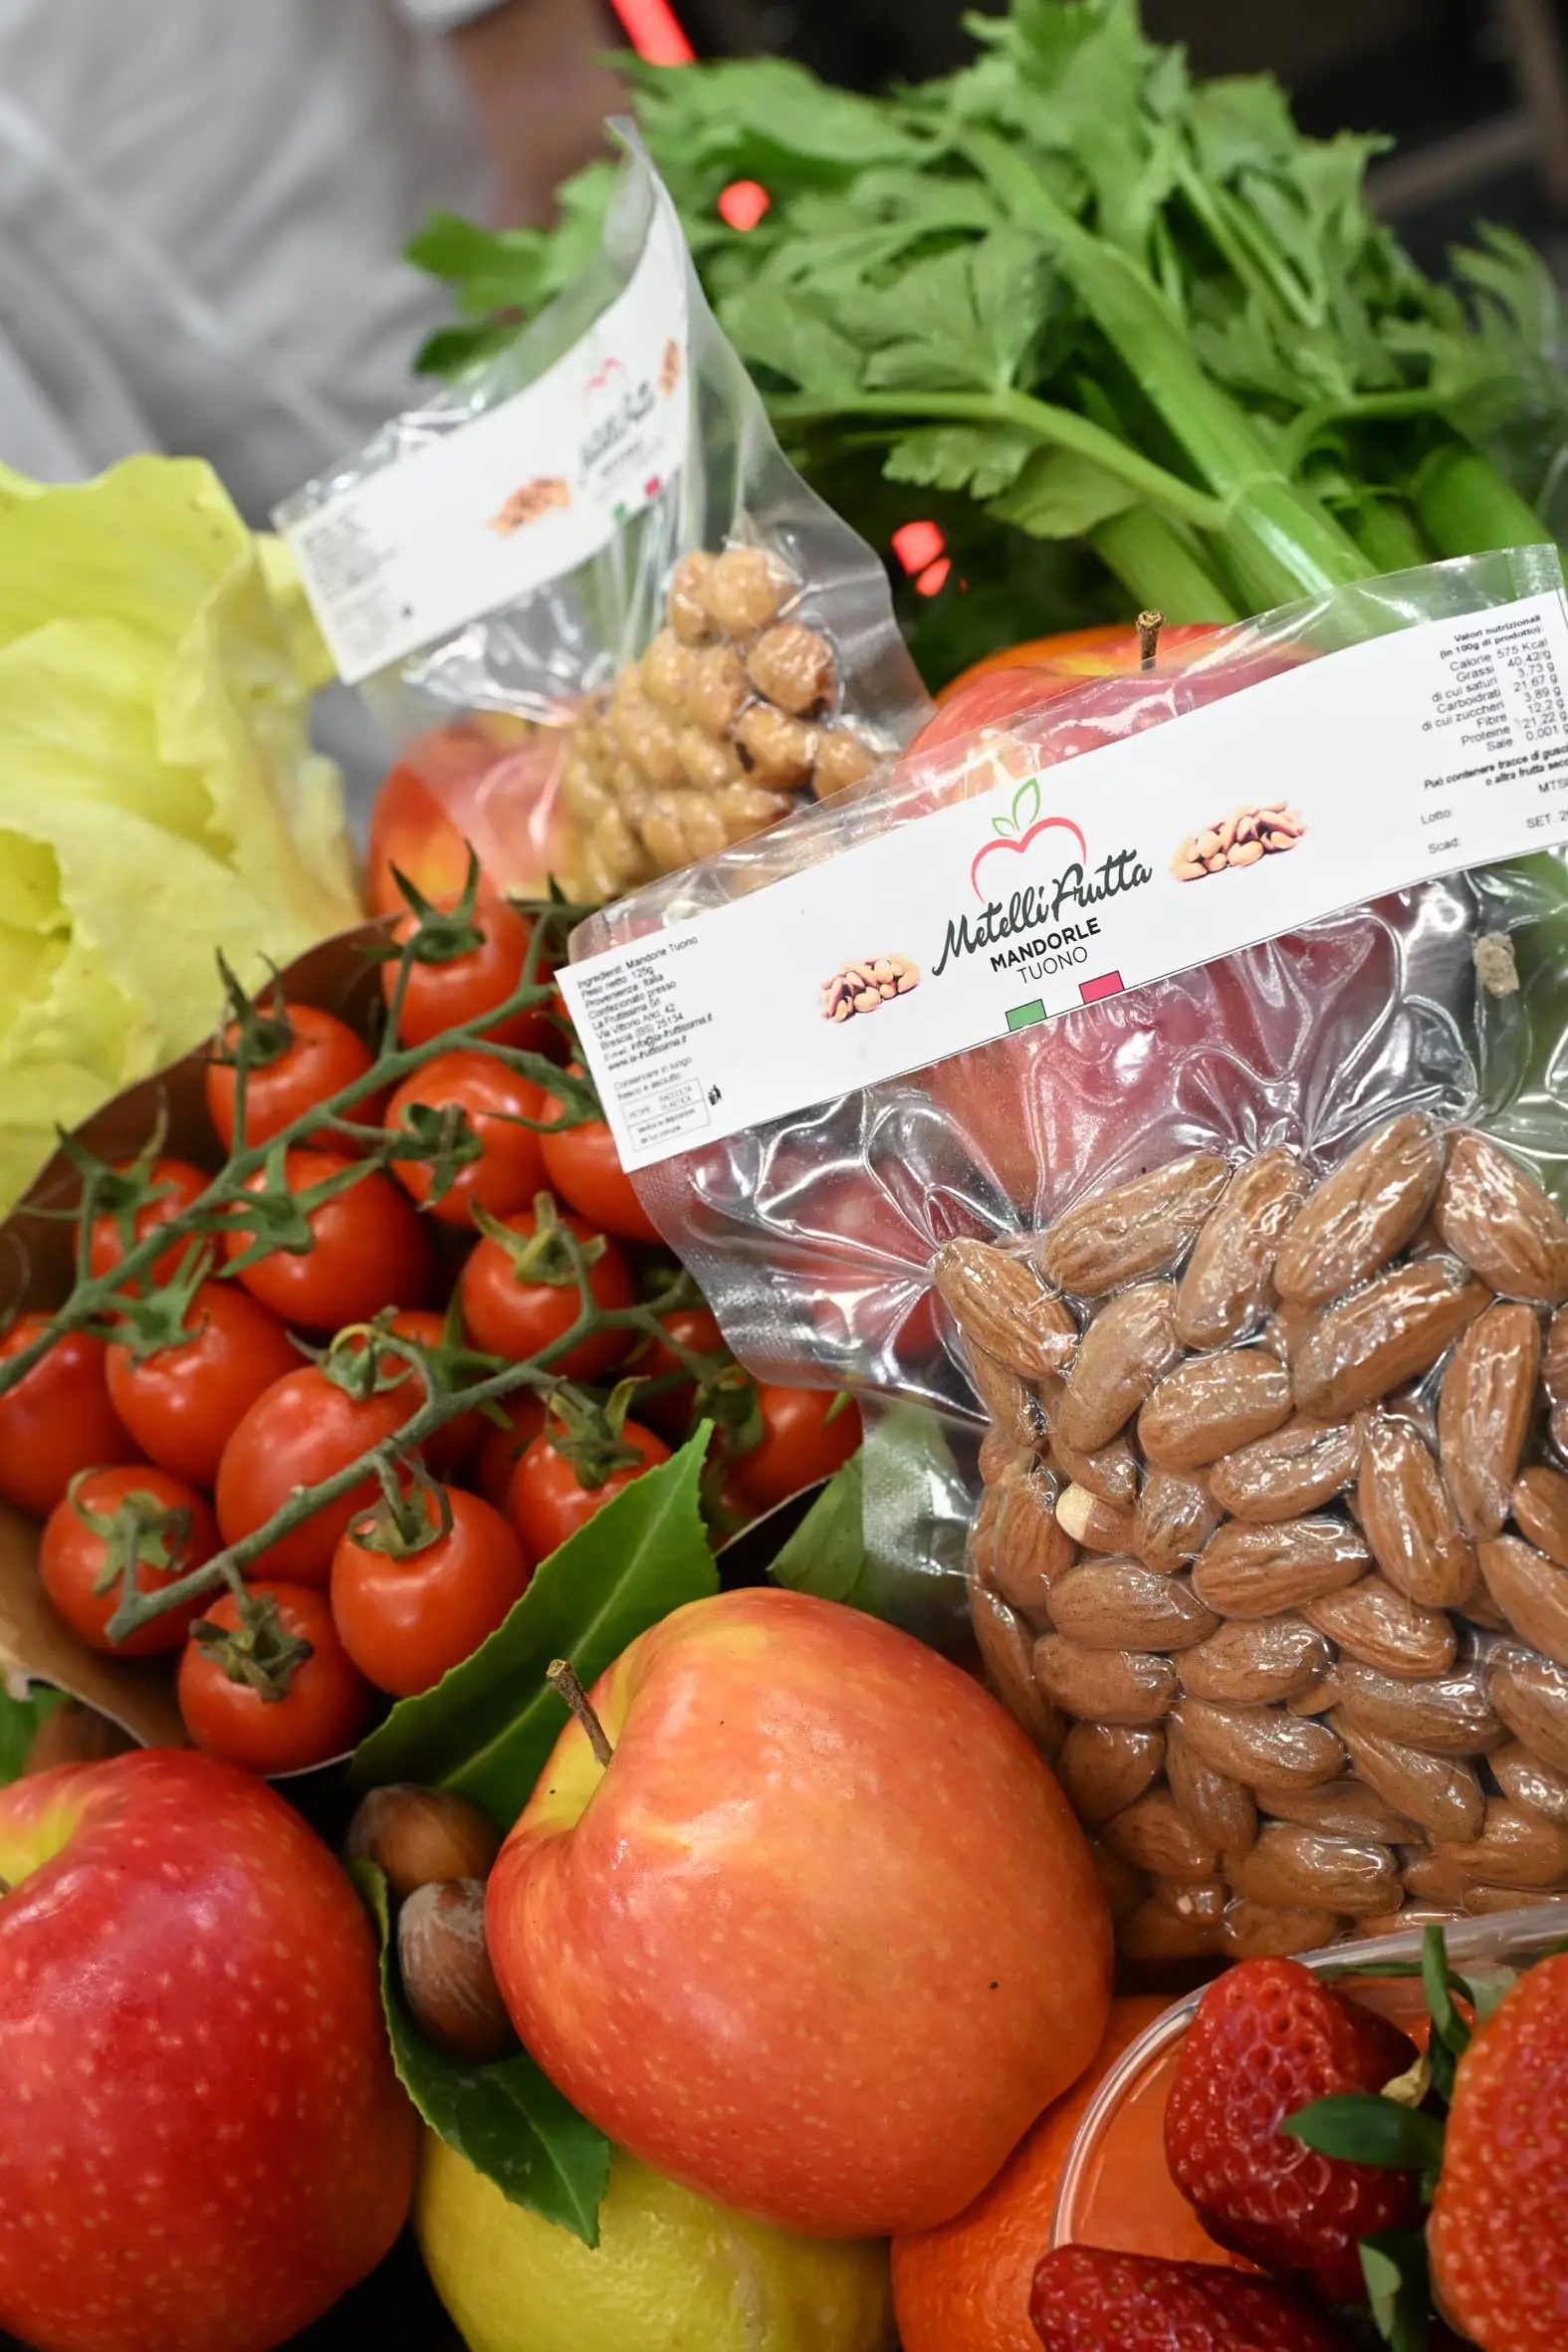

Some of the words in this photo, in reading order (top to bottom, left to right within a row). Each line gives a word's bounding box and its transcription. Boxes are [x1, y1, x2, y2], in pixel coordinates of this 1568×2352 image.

[1454, 629, 1483, 642] Valori
[1485, 614, 1541, 635] nutrizionali
[1450, 654, 1491, 672] Calorie
[1496, 645, 1519, 659] 575
[1521, 637, 1549, 652] Kcal
[1456, 642, 1480, 653] 100g
[1456, 664, 1495, 683] Grassi
[1432, 692, 1443, 703] di
[1445, 686, 1463, 699] cui
[1465, 676, 1498, 693] saturi
[1437, 688, 1501, 714] Carboidrati
[1422, 721, 1433, 732] di
[1435, 715, 1454, 728] cui
[1455, 700, 1505, 723] zuccheri
[1476, 713, 1507, 729] Fibre
[1460, 726, 1511, 747] Proteine
[1486, 738, 1513, 752] Sale
[1425, 777, 1445, 790] Può
[1446, 765, 1495, 784] contenere
[1497, 756, 1529, 770] tracce
[1530, 750, 1540, 762] di
[1494, 772, 1516, 784] altra
[1518, 765, 1545, 778] frutta
[1526, 813, 1551, 829] SET
[932, 885, 1050, 977] Metelli
[1051, 848, 1153, 922] Frutta
[668, 936, 699, 953] Tuono
[990, 917, 1101, 973] MANDORLE
[1015, 946, 1089, 984] TUONO
[580, 986, 603, 999] Peso
[631, 966, 655, 979] 125g
[642, 974, 664, 987] Italia
[588, 993, 646, 1021] Confezionato
[646, 981, 677, 1000] presso
[592, 1021, 604, 1031] La
[603, 1003, 648, 1025] Fruttissima
[595, 1030, 611, 1040] Via
[610, 1018, 641, 1035] Vittorio
[664, 1003, 676, 1014] 42
[599, 1033, 634, 1052] Brescia
[634, 1024, 655, 1040] (BS)
[655, 1012, 685, 1030] 25134
[613, 1069, 660, 1090] Conservare
[669, 1057, 693, 1070] luogo
